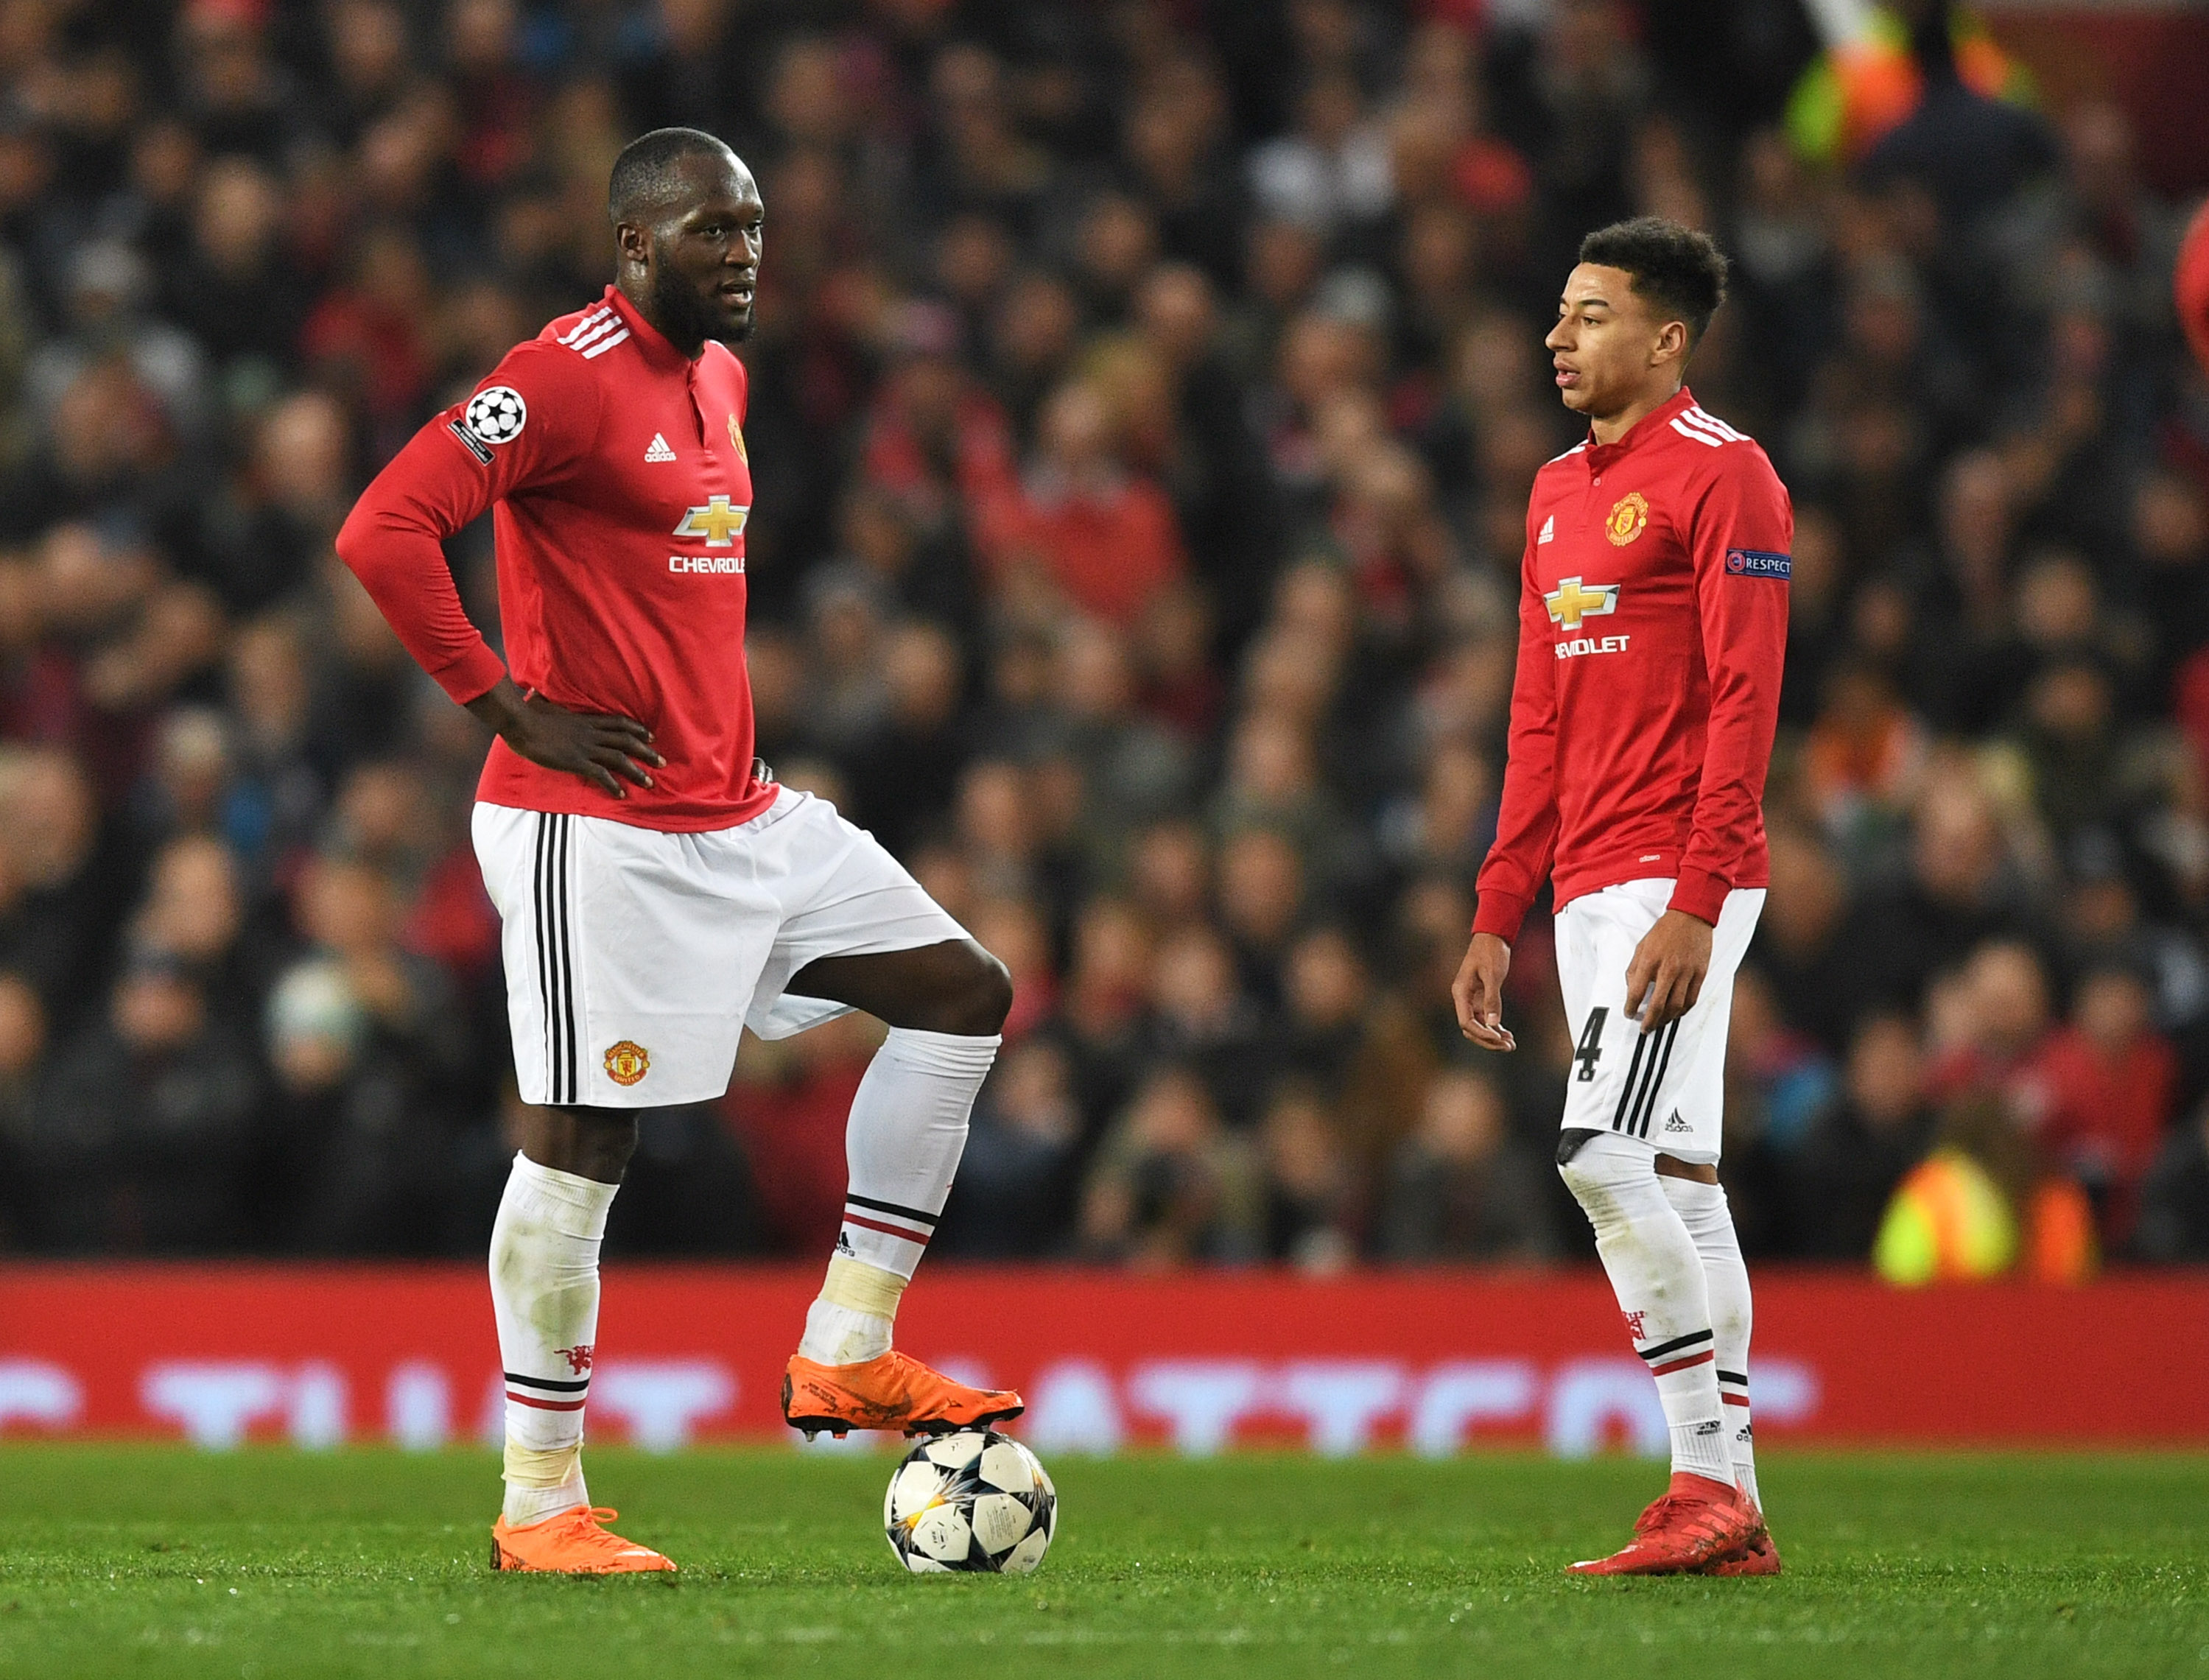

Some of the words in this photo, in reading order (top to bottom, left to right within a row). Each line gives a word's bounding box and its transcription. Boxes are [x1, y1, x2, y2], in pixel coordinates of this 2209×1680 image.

[645, 451, 676, 463] adidas
[669, 556, 745, 573] CHEVROLE
[1746, 558, 1791, 573] RESPECT
